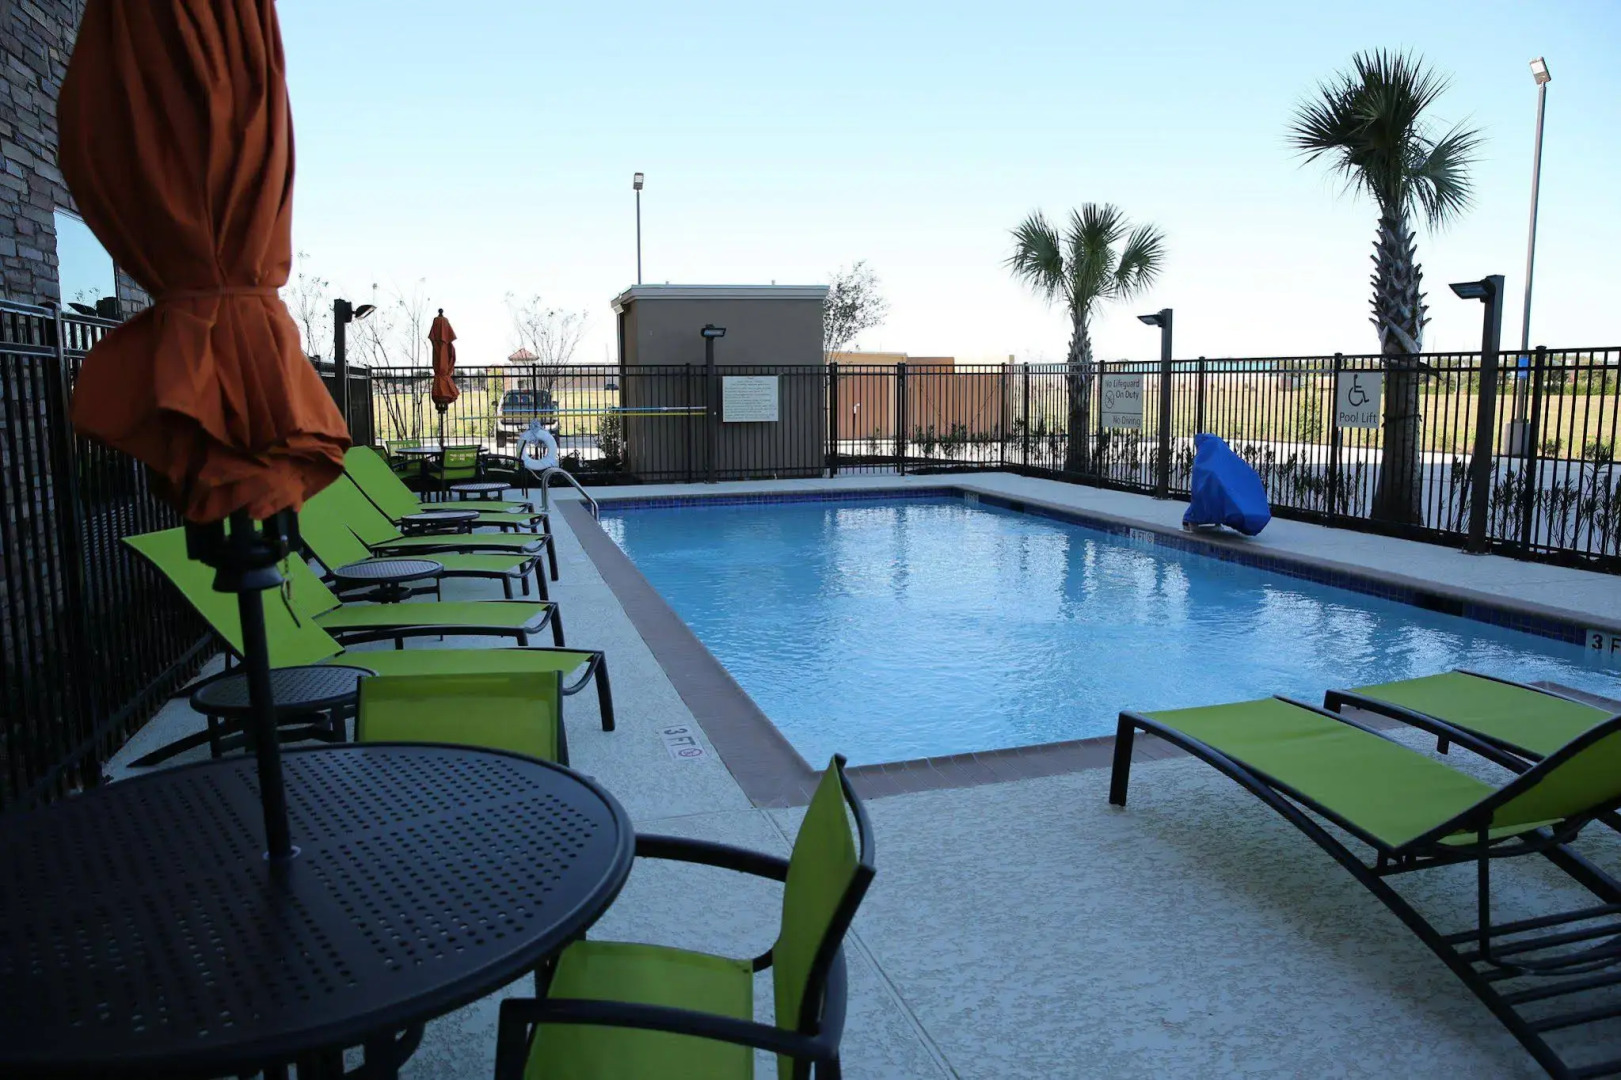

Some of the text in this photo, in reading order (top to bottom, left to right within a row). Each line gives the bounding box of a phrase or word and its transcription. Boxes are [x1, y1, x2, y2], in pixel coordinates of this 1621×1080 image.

[1105, 379, 1140, 390] No Lifeguard
[1115, 390, 1140, 401] On Duty
[1112, 415, 1141, 428] No Diving
[1339, 411, 1377, 424] Pool Lift
[1591, 634, 1603, 650] 3
[666, 736, 696, 747] FT
